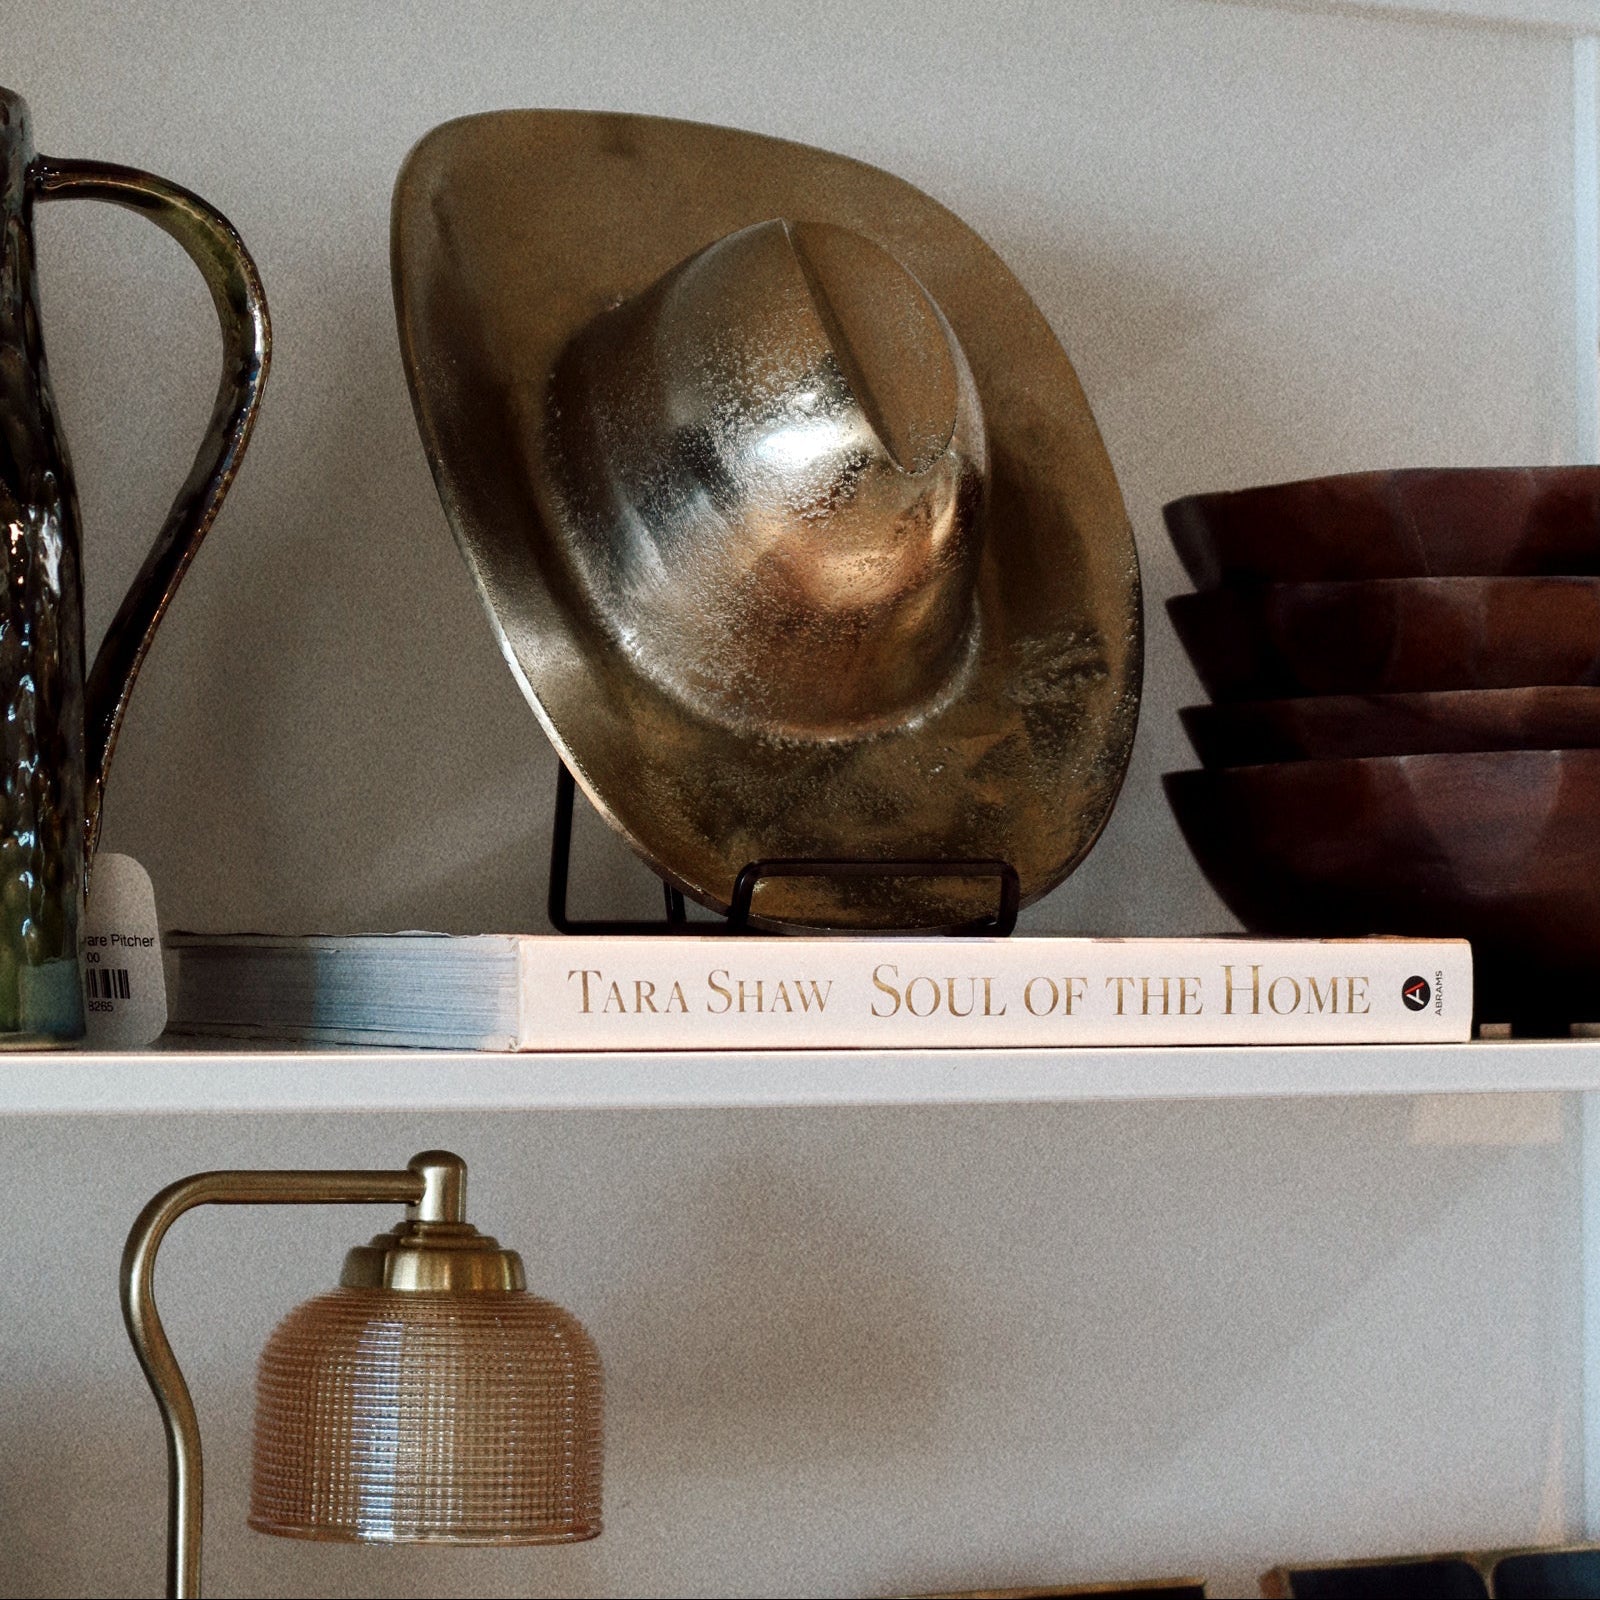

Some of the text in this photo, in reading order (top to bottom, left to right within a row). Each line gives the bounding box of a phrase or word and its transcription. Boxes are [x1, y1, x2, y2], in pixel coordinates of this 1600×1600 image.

[111, 934, 154, 947] Pitcher
[568, 964, 1371, 1018] TARA SHAW SOUL OF THE HOME
[1434, 970, 1443, 1017] ABRAMS
